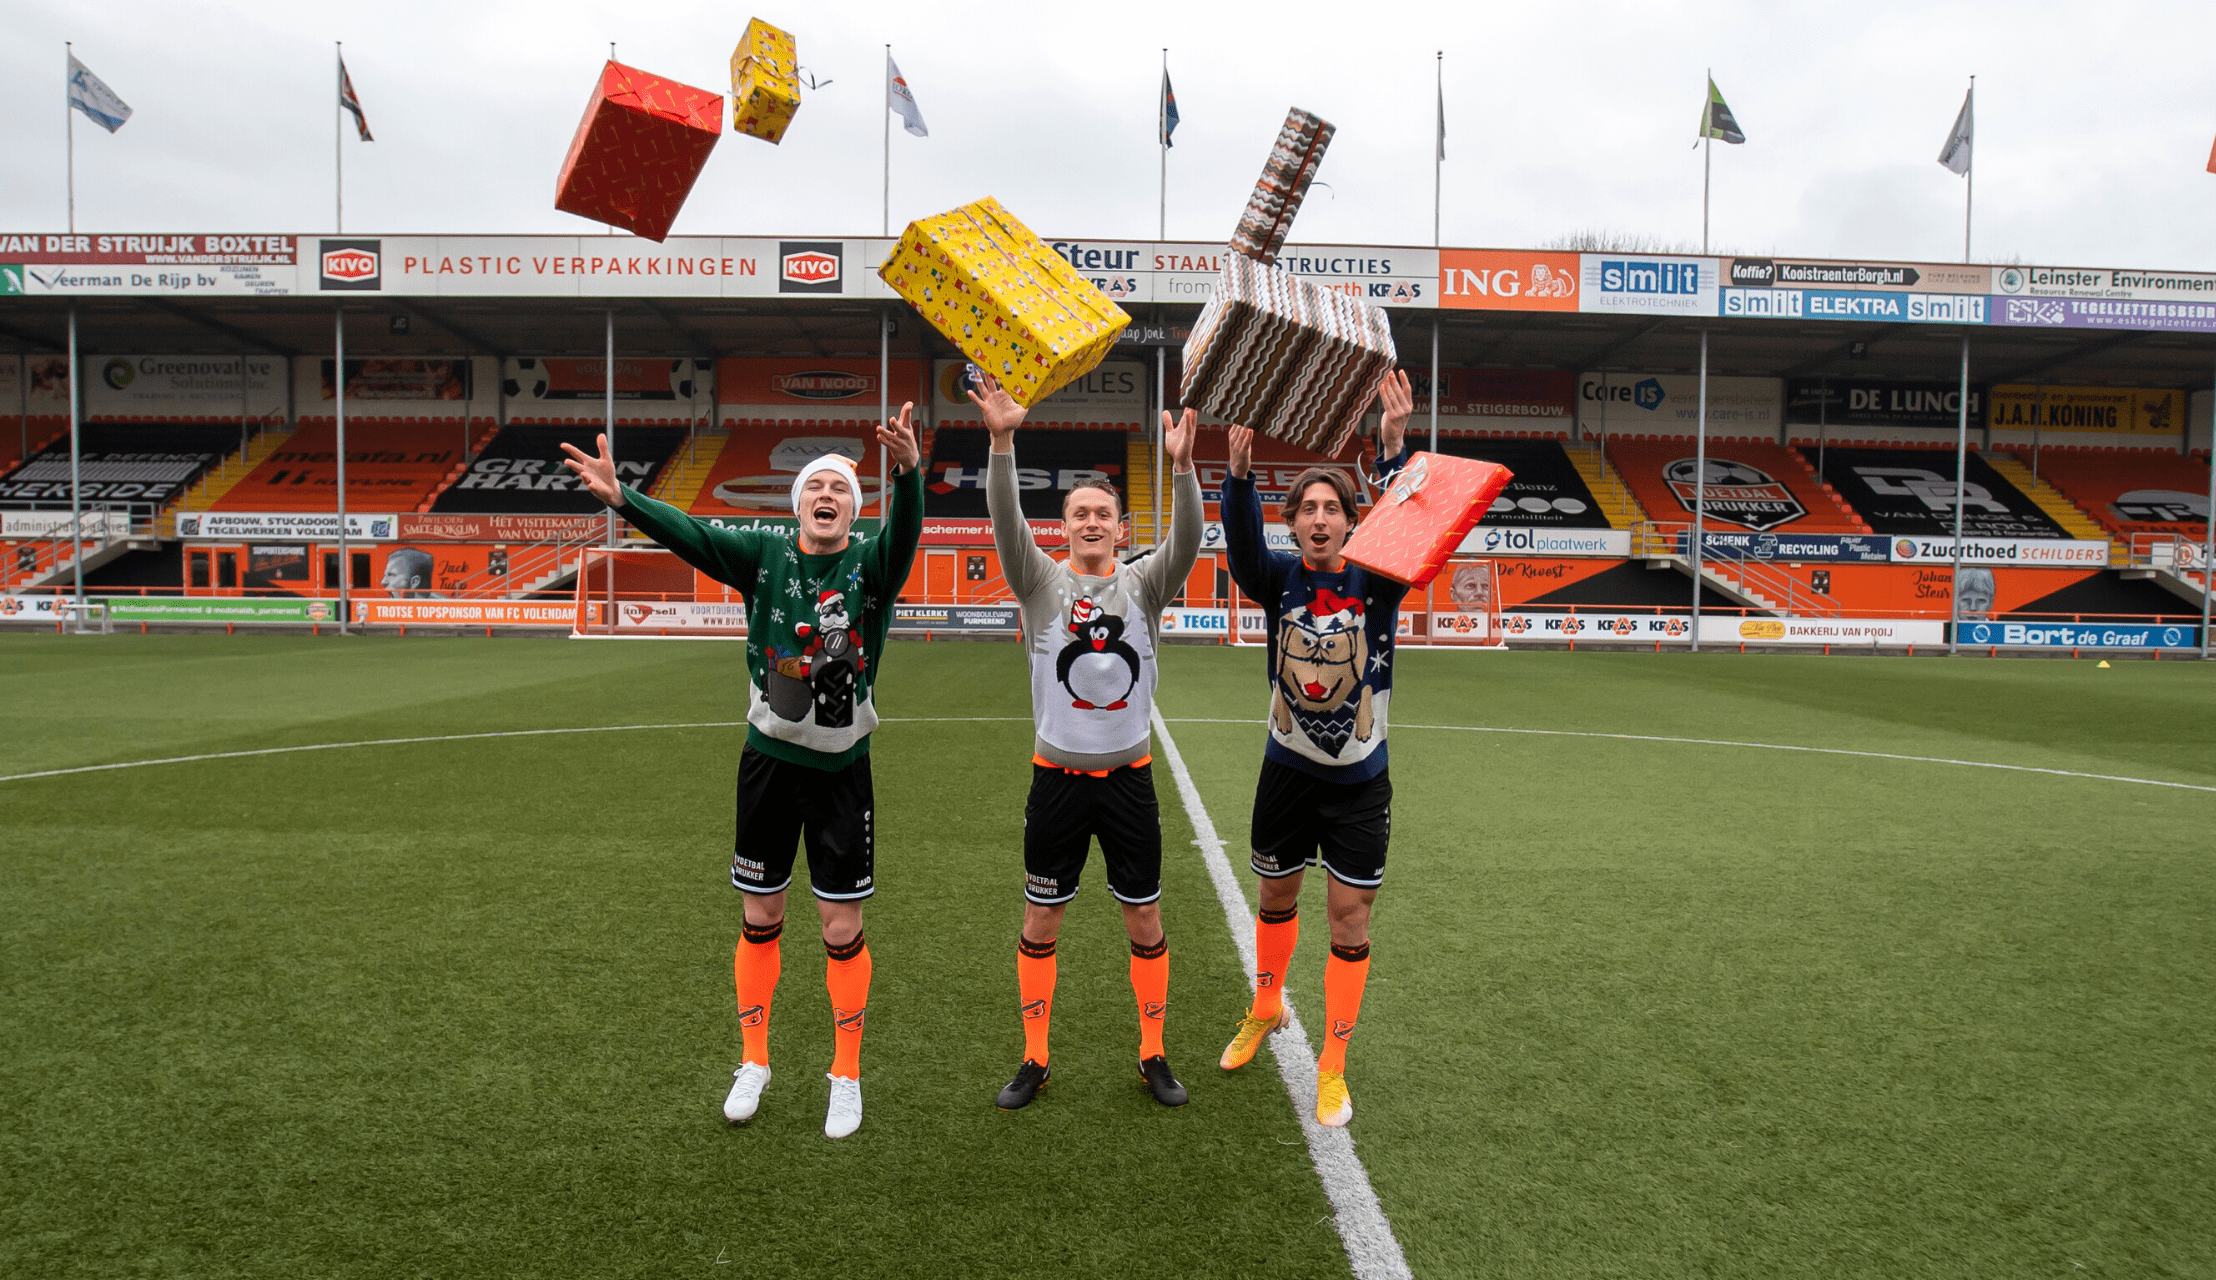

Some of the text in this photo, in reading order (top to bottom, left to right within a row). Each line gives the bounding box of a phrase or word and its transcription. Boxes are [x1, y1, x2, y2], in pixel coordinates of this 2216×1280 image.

[0, 237, 294, 253] VAN DER STRUIJK BOXTEL
[327, 258, 372, 273] KIVO
[404, 257, 757, 276] PLASTIC VERPAKKINGEN
[788, 260, 833, 275] KIVO
[1154, 255, 1391, 274] STAAL STRUCTIES
[1604, 265, 1697, 293] smit
[1733, 265, 1773, 280] Koffie?
[1782, 265, 1904, 285] KooistraenterBorgh.nl
[2030, 268, 2216, 291] Leinster Environmen
[131, 274, 153, 287] De
[158, 274, 191, 290] Rijp
[197, 274, 217, 287] bv
[1169, 278, 1211, 293] from
[1443, 268, 1521, 296] ING
[1368, 282, 1421, 298] KRAS
[2030, 287, 2133, 298] Resource Renewal Centre
[1600, 297, 1698, 308] ELEKTROTECHNIEK
[1728, 292, 1800, 313] smit
[1811, 297, 1899, 315] ELEKTRA
[1911, 295, 1983, 318] smit
[1116, 328, 1140, 343] aap
[139, 357, 270, 375] Greenovatve
[781, 377, 815, 390] VAN
[1582, 381, 1632, 402] Care
[1850, 389, 1882, 410] DE
[1891, 390, 1979, 413] LUNCH
[1467, 402, 1564, 416] STEIGERBOUW
[1675, 407, 1770, 421] ww.care-is.nl
[1700, 501, 1789, 512] DRUKKER
[267, 517, 341, 526] STUCADOOR
[206, 527, 292, 536] TEGELWERKEN
[497, 529, 521, 539] VAN
[923, 524, 983, 535] schermer
[1505, 528, 1608, 553] tol plaatwerk
[1706, 535, 1749, 546] SCHENK
[1778, 543, 1839, 555] RECYCLING
[1920, 543, 2104, 561] Zwarthoed SCHILDERS
[438, 560, 469, 576] Jack
[1915, 583, 1950, 599] Steur
[376, 605, 577, 620] TROTSE TOPSPONSOR VAN FC VOLENDAM
[896, 609, 948, 617] PIET KLERKX
[1183, 615, 1227, 629] TEGEL
[1437, 616, 1478, 630] KRAS
[1492, 617, 1532, 631] KRAS
[1545, 618, 1585, 632] KRAS
[1598, 618, 1638, 632] KRAS
[1649, 619, 1689, 633] KRAS
[1790, 626, 1839, 637] BAKKERIJ
[1842, 627, 1861, 637] VAN
[1864, 627, 1893, 637] POOIJ
[2004, 624, 2149, 646] Bort de Graaf
[736, 855, 765, 871] VOETBAL
[735, 867, 765, 881] DRUKKER
